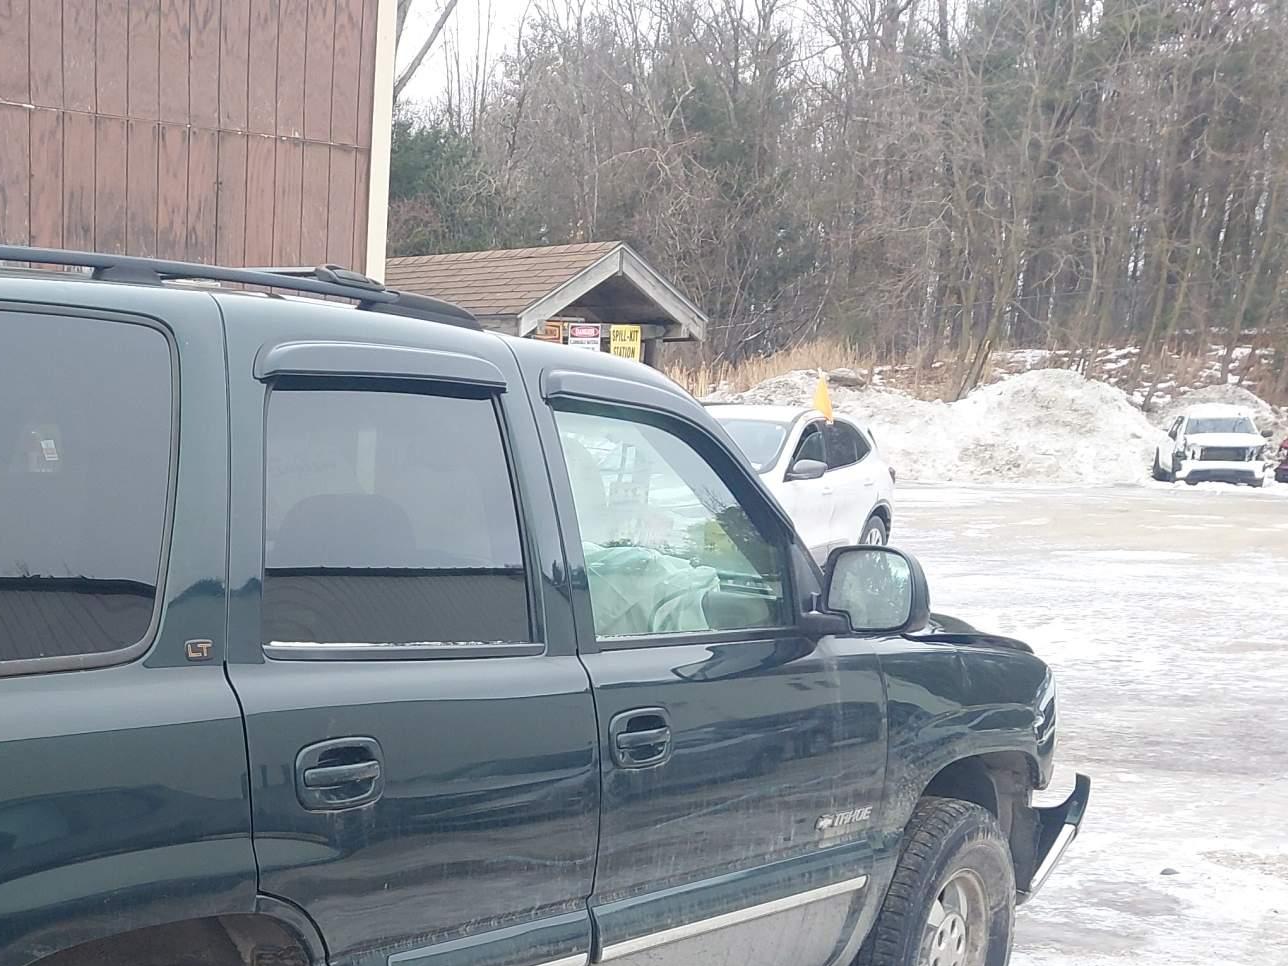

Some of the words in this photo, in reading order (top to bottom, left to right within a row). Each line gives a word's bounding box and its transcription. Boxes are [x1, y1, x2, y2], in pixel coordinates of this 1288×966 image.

[613, 329, 639, 342] SPILL-KIT
[614, 346, 635, 358] STATION
[187, 643, 212, 657] LT
[834, 806, 873, 826] TAHOE
